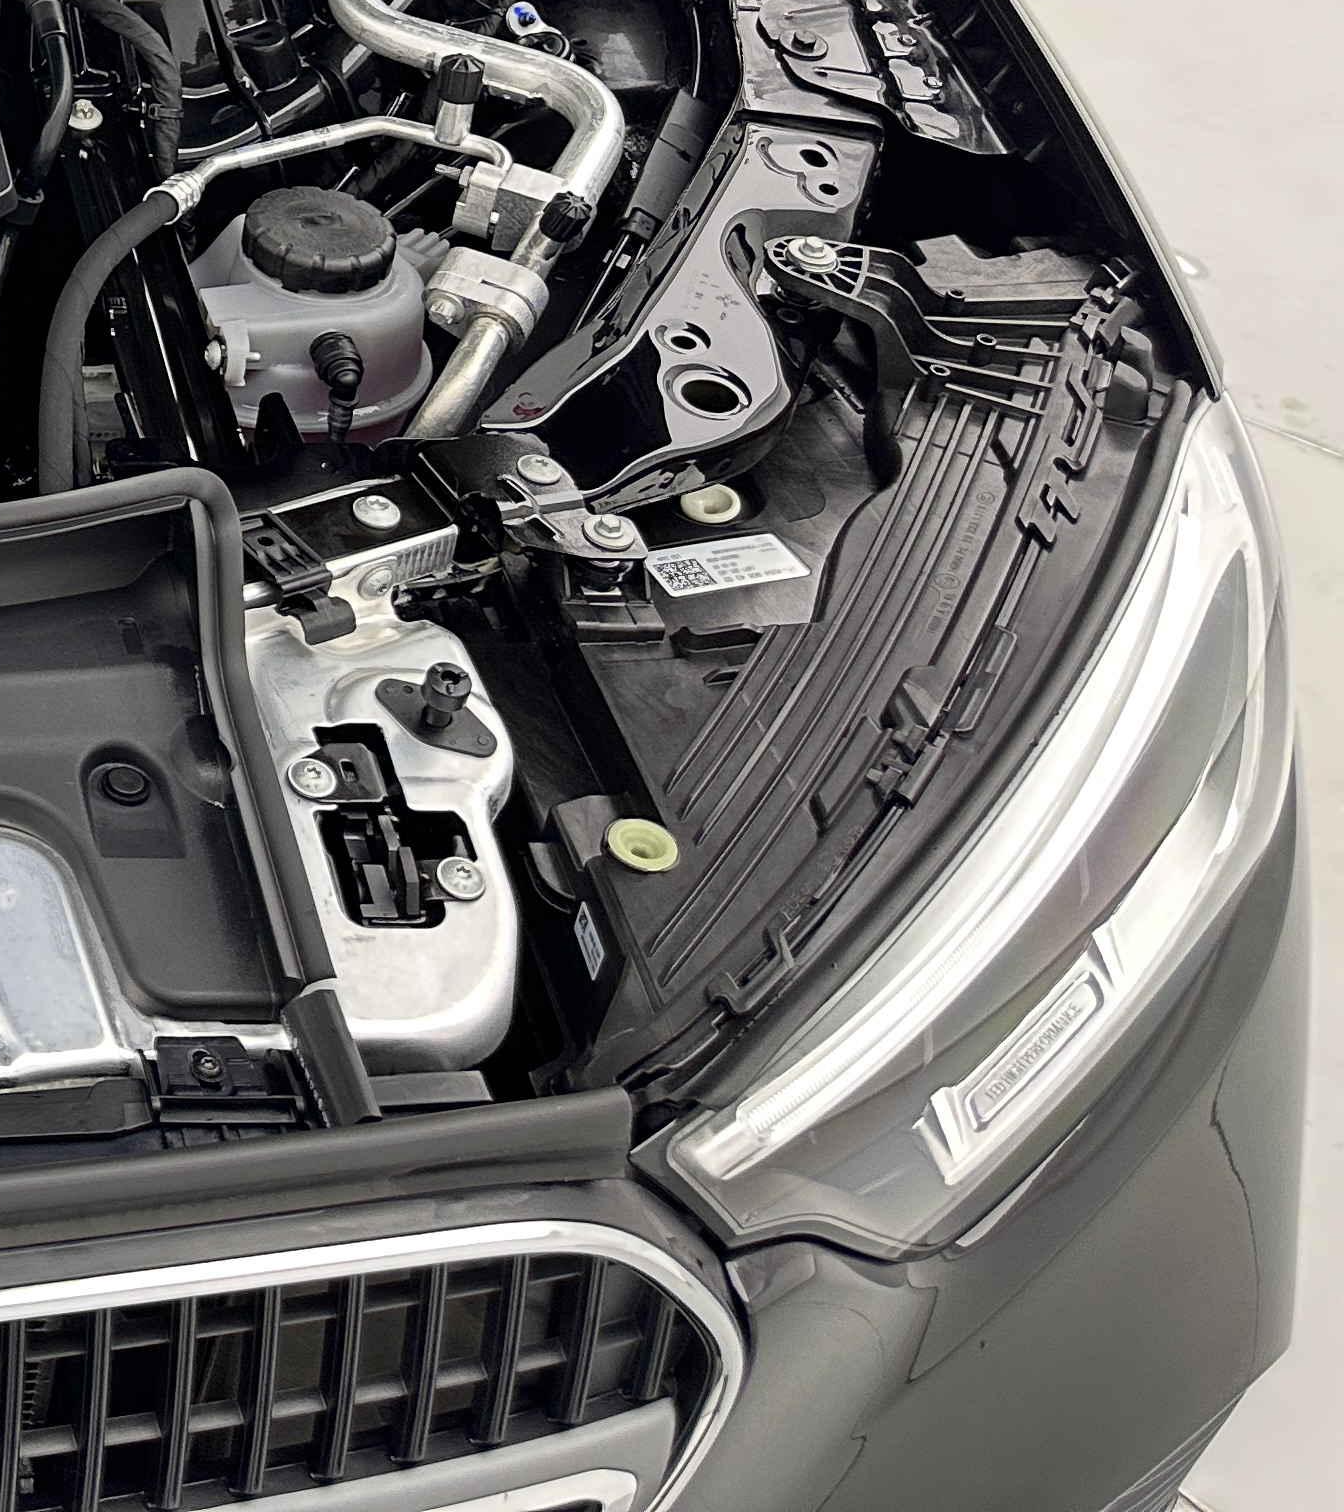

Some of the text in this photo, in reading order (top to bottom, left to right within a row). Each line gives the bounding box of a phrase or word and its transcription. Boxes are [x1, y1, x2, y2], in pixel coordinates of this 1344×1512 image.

[985, 1002, 1081, 1100] LED HIGH PERFORMANCE
